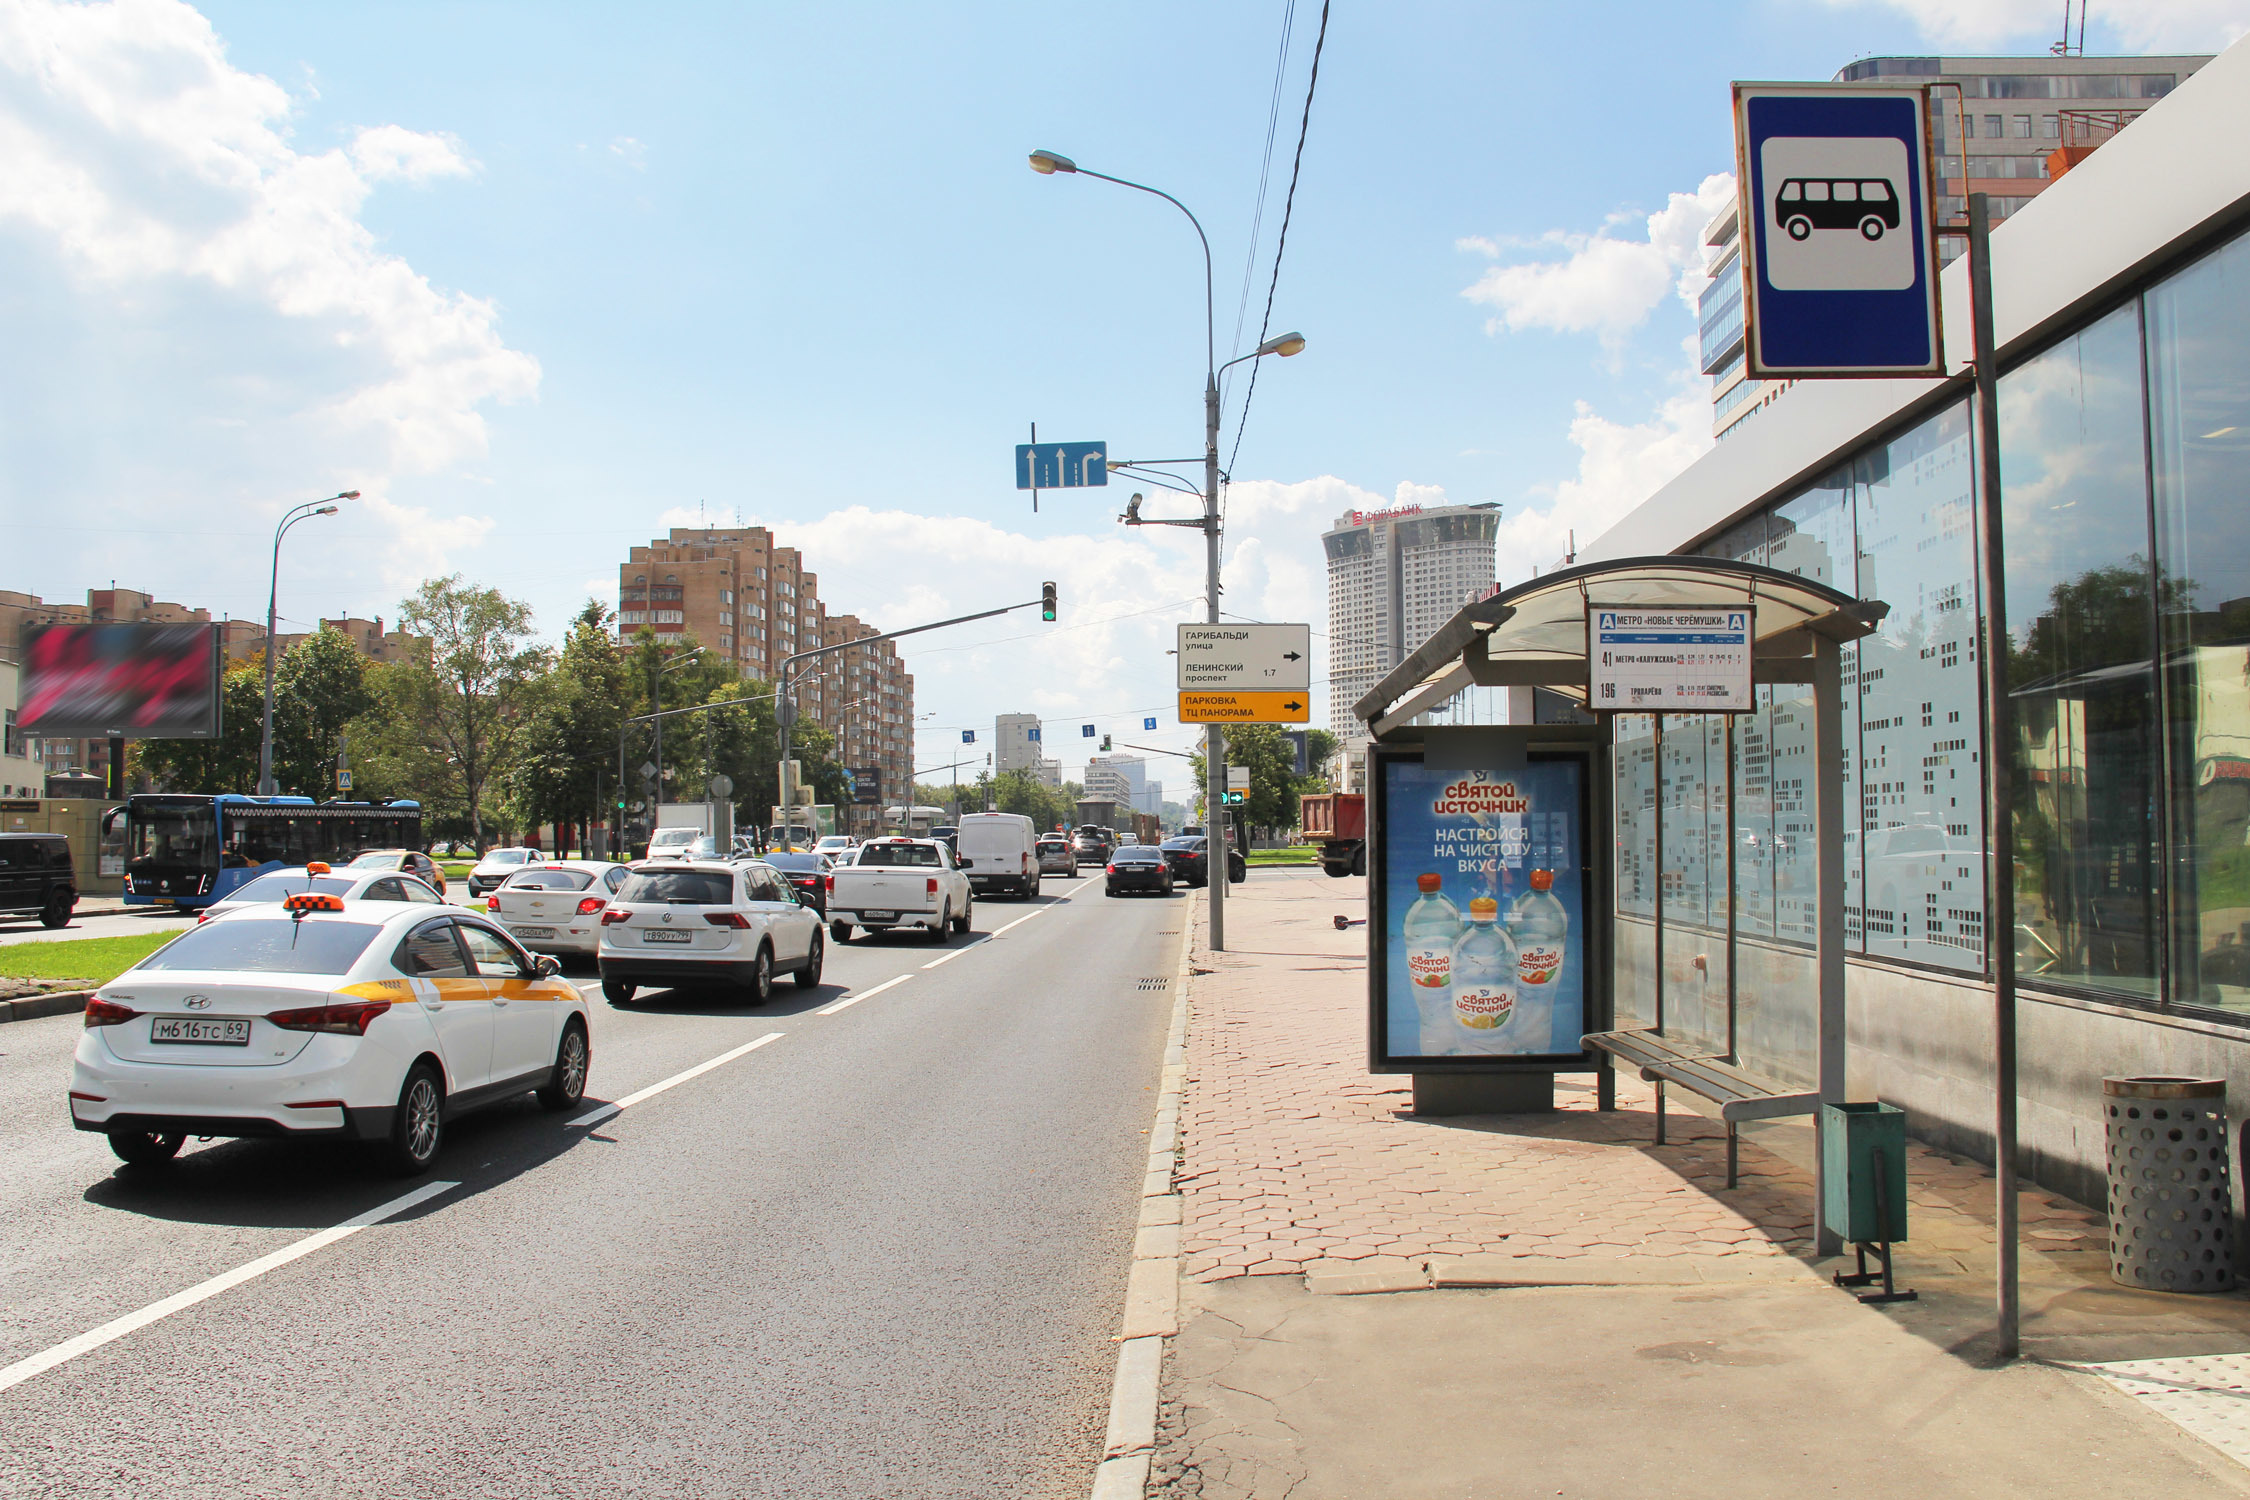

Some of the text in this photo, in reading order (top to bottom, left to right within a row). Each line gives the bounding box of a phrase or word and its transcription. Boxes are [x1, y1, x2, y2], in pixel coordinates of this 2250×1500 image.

[1617, 616, 1642, 625] МЕТРО
[1186, 632, 1249, 640] ГАРИБАЛЬДИ
[1186, 643, 1213, 651] улица
[1602, 651, 1612, 667] 41
[1616, 655, 1635, 663] МЕТРО
[1185, 663, 1244, 672] ЛЕНИНСКИЙ
[1264, 669, 1276, 677] 1.7
[1186, 675, 1227, 683] проспект
[1600, 683, 1616, 698] 196
[1185, 697, 1237, 705] ПАРКОВКА
[1186, 709, 1254, 718] ТЦ ПАНОРАМА
[1435, 827, 1529, 842] НАСТРОЙСЯ
[1434, 842, 1531, 857] НА ЧИСТОТУ
[1458, 859, 1508, 873] ВКУСА
[160, 1021, 244, 1039] М616ТС 69
